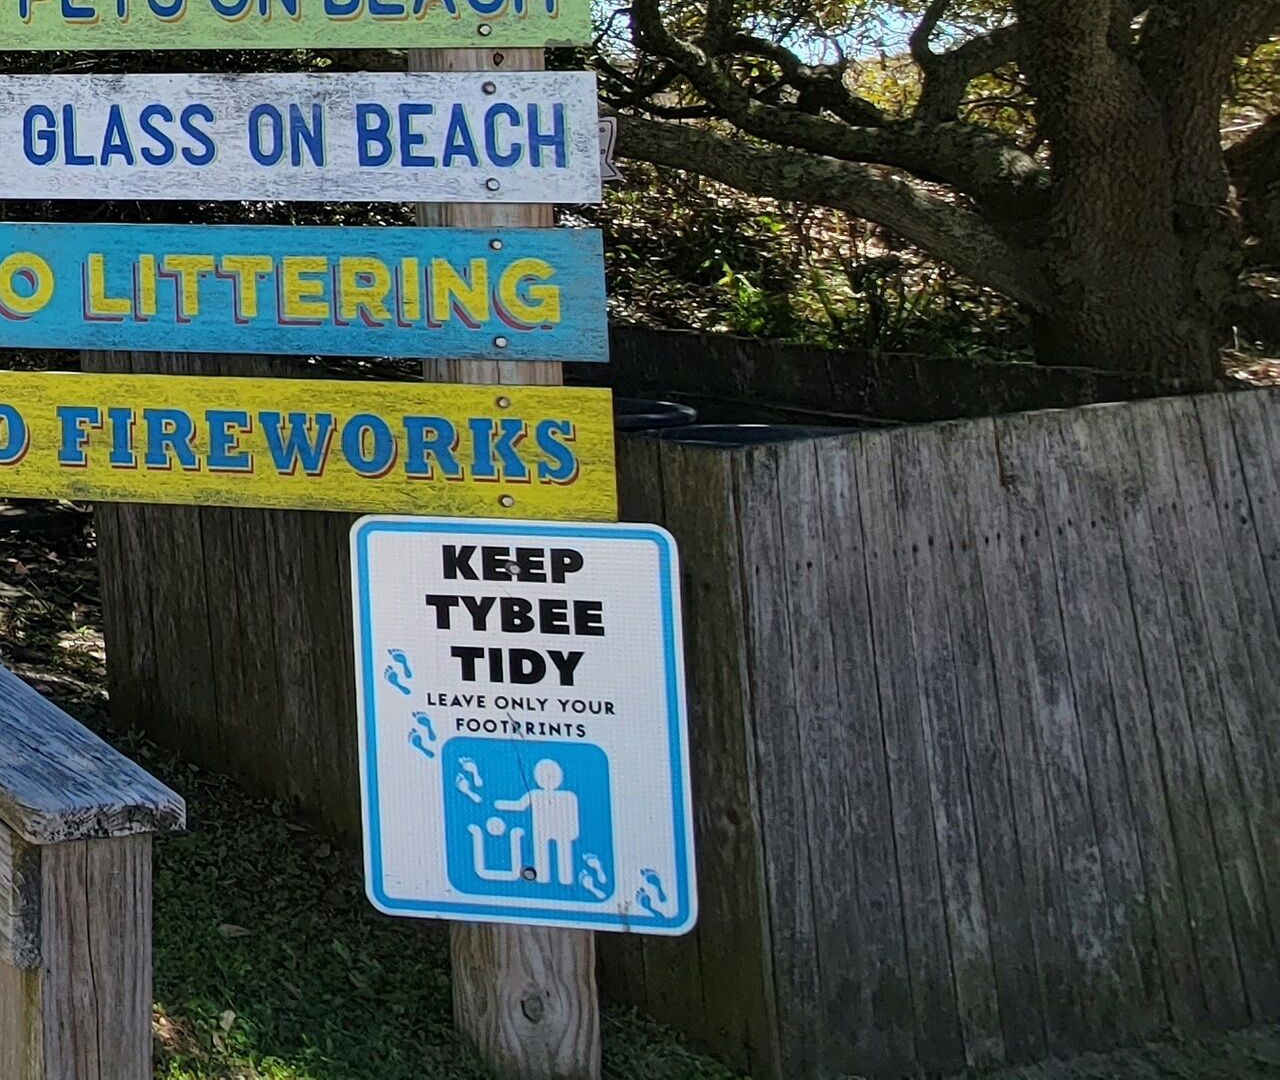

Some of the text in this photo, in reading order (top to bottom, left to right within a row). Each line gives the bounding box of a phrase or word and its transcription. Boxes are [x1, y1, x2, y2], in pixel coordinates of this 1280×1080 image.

[23, 103, 218, 167] GLASS
[248, 103, 327, 168] ON
[357, 103, 569, 169] BEACH
[82, 252, 562, 330] LITTERING
[57, 405, 578, 485] FIREWORKS
[442, 544, 584, 584] KEEP
[425, 594, 605, 637] TYBEE
[450, 646, 585, 686] TIDY
[427, 692, 616, 715] LEAVE ONLY YOUR
[455, 718, 587, 738] FOOTPRINTS
